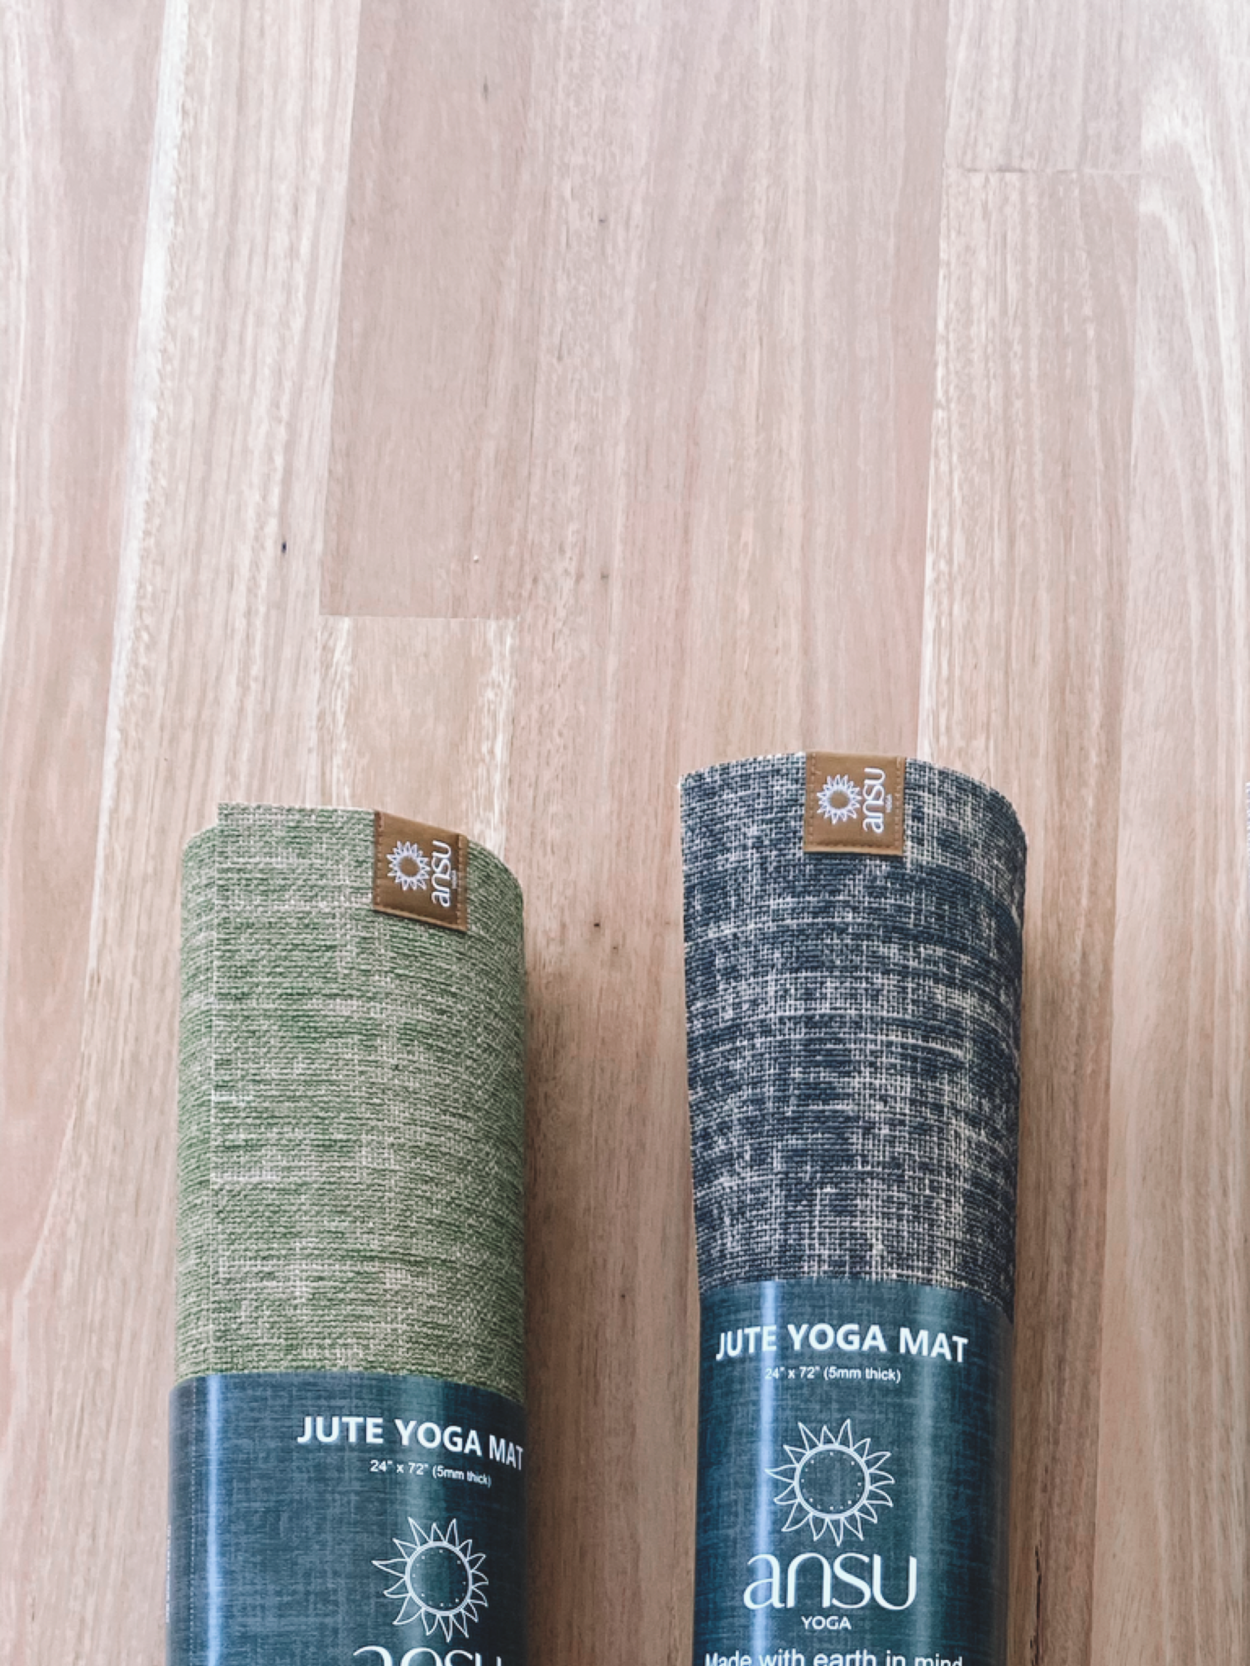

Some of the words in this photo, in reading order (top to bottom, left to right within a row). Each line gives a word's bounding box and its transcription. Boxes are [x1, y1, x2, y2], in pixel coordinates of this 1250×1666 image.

[863, 767, 886, 834] ansu
[431, 840, 451, 907] ansu
[715, 1325, 777, 1361] JUTE
[787, 1323, 887, 1353] YOGA
[899, 1327, 969, 1363] MAT
[765, 1366, 785, 1380] 24"
[788, 1370, 796, 1380] x
[799, 1366, 821, 1379] 72"
[823, 1365, 862, 1382] (5mm
[865, 1367, 902, 1384] thick)
[297, 1415, 384, 1445] JUTE
[394, 1418, 482, 1457] YOGA
[489, 1434, 524, 1471] MAT
[370, 1459, 393, 1474] 24"
[396, 1464, 405, 1475] x
[408, 1462, 429, 1476] 72"
[432, 1465, 465, 1481] (5mm
[466, 1469, 492, 1488] thick)
[743, 1552, 917, 1611] ansu
[801, 1615, 852, 1630] YOGA
